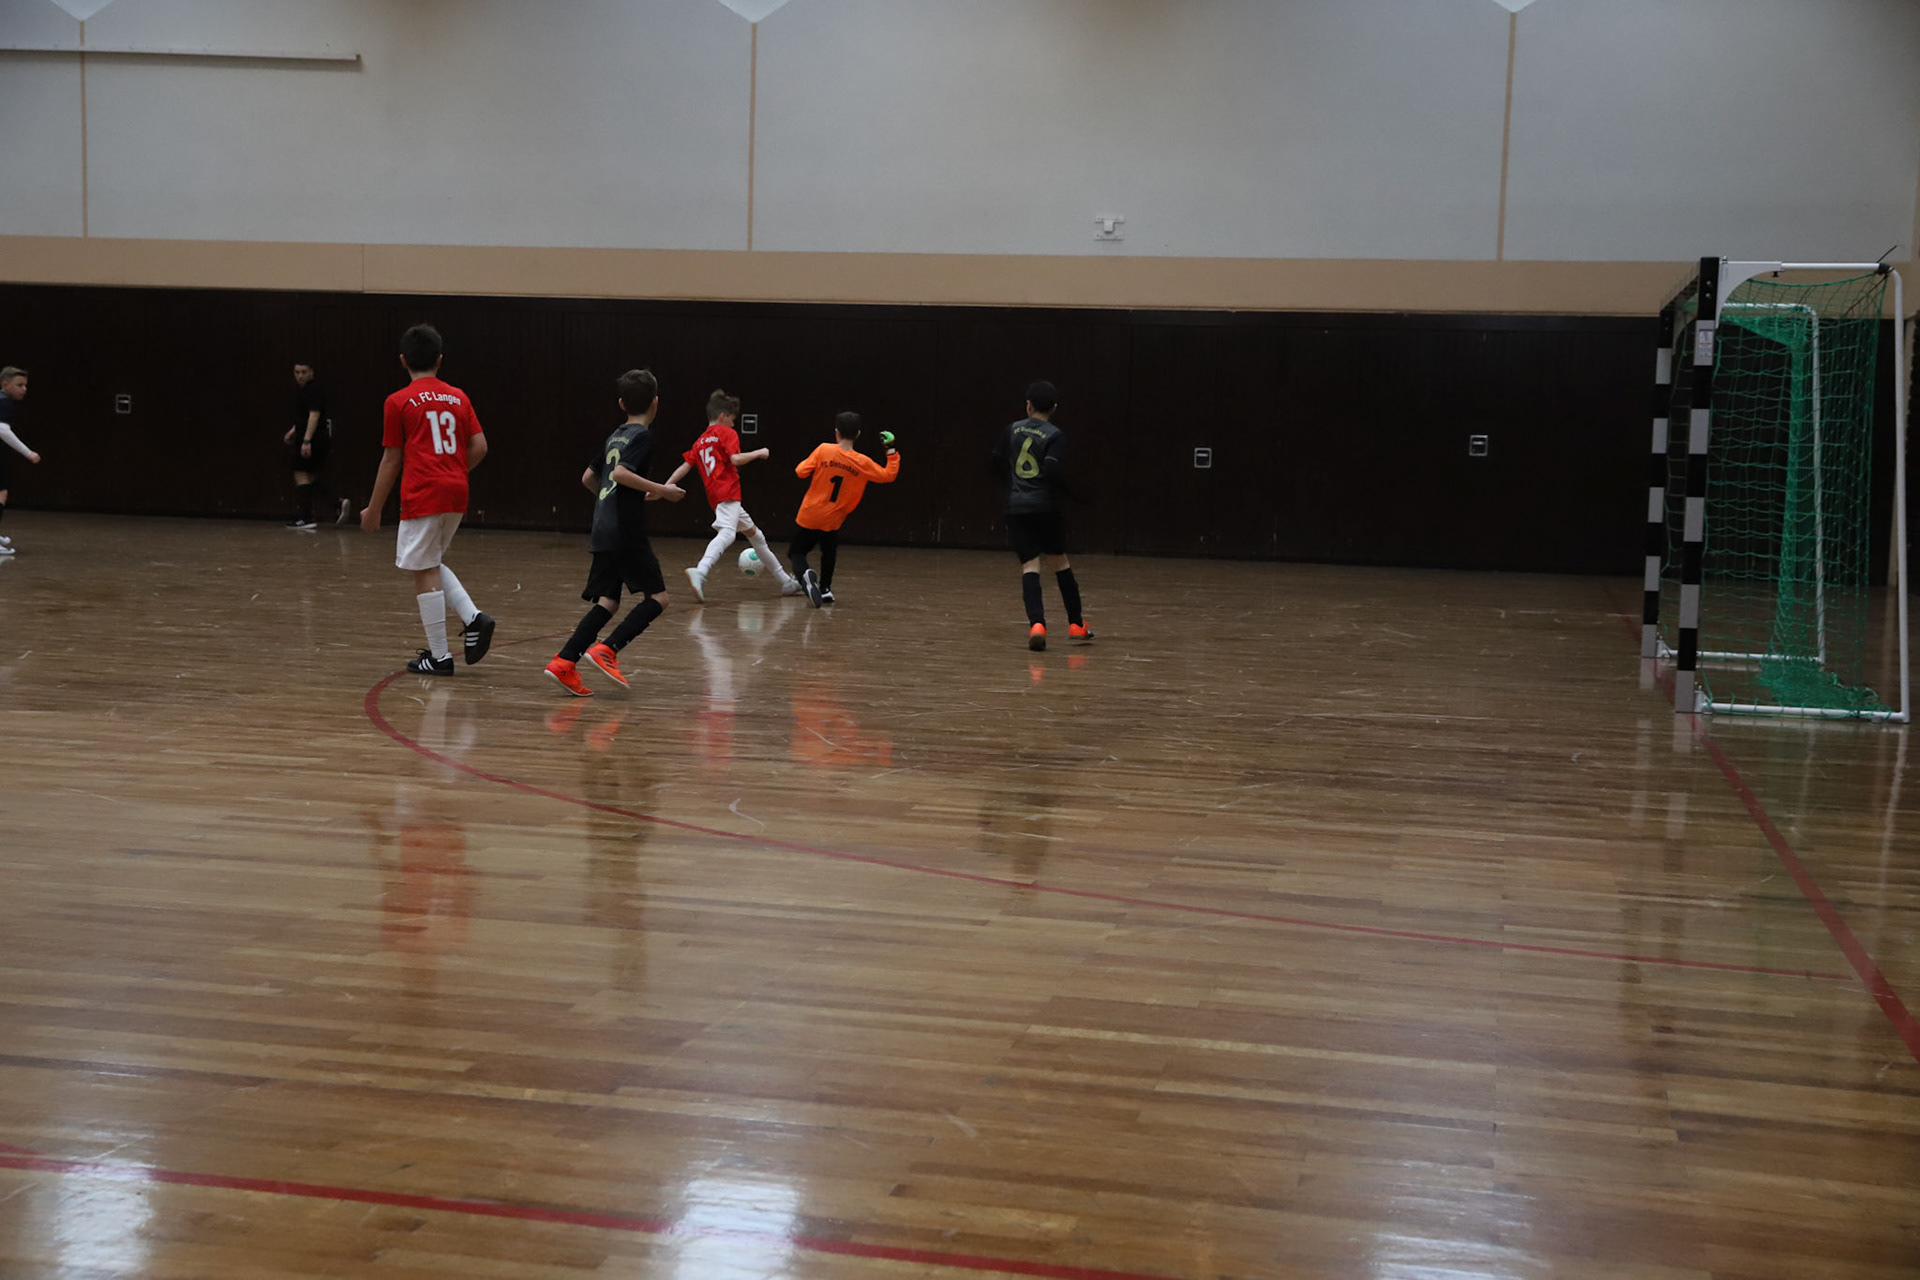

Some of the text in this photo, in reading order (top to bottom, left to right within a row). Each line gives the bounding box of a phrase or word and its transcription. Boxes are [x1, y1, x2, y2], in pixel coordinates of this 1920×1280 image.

[409, 391, 461, 408] 1. FC Langen
[425, 410, 457, 455] 13
[599, 447, 621, 500] 3
[699, 446, 717, 477] 15
[1015, 436, 1040, 480] 6
[830, 475, 844, 503] 1
